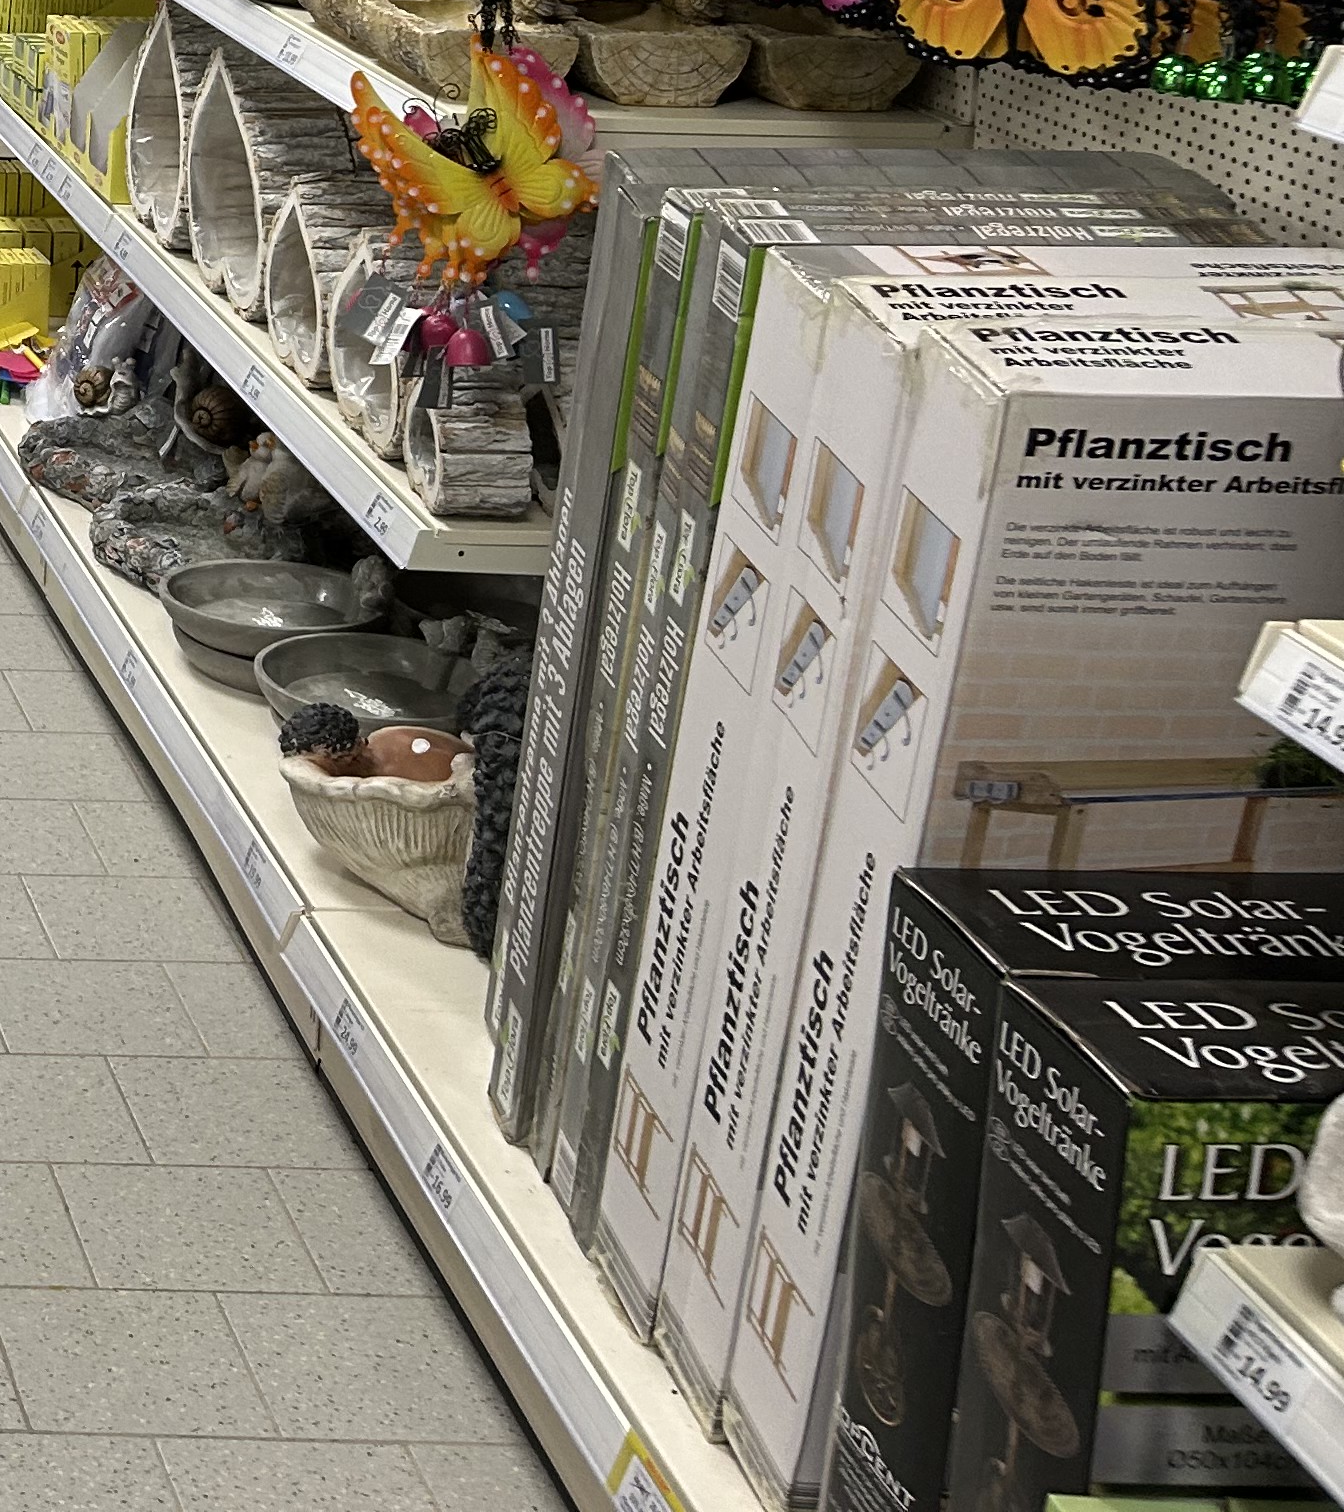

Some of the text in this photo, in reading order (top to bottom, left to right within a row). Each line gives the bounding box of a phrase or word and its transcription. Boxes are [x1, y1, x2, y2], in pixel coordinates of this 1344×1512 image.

[970, 224, 1094, 241] Holzregal
[871, 282, 1127, 301] Pflanztisch
[889, 300, 1075, 312] mit verzinkter
[968, 327, 1241, 345] Pflanztisch
[990, 344, 1186, 358] mit verzinkter
[1005, 357, 1192, 369] Arbeitsfläche
[1024, 426, 1294, 462] Pflanztisch
[626, 468, 638, 497] Top
[1016, 472, 1064, 489] mit
[1073, 473, 1218, 494] verzinkter
[373, 516, 389, 537] 2.99
[599, 560, 632, 688] Holzregal
[624, 623, 656, 754] Holzregal
[648, 615, 685, 750] Holzregal
[509, 537, 586, 986] Pflanzentreppe mit 3 Ablagen
[658, 721, 726, 1070] mit verzinkter Arbeitsfläche
[987, 888, 1328, 920] LED Solar-
[637, 811, 689, 1046] Pflanztisch
[725, 786, 795, 1152] mit verzinkter Arbeitsfläche
[893, 906, 929, 963] LED
[930, 949, 983, 1016] Solar-
[704, 879, 761, 1125] Pflanztisch
[888, 940, 983, 1065] Vogeltränke
[1102, 999, 1258, 1031] LED
[340, 1025, 359, 1056] 24.99
[796, 851, 877, 1236] mit verzinkter Arbeitsfläche
[773, 948, 835, 1209] Pflanztisch
[999, 1019, 1043, 1080] LED
[1043, 1067, 1106, 1138] Solar-
[995, 1058, 1108, 1192] Vogeltränke
[1157, 1141, 1310, 1201] LED
[1237, 1354, 1292, 1414] 14.99
